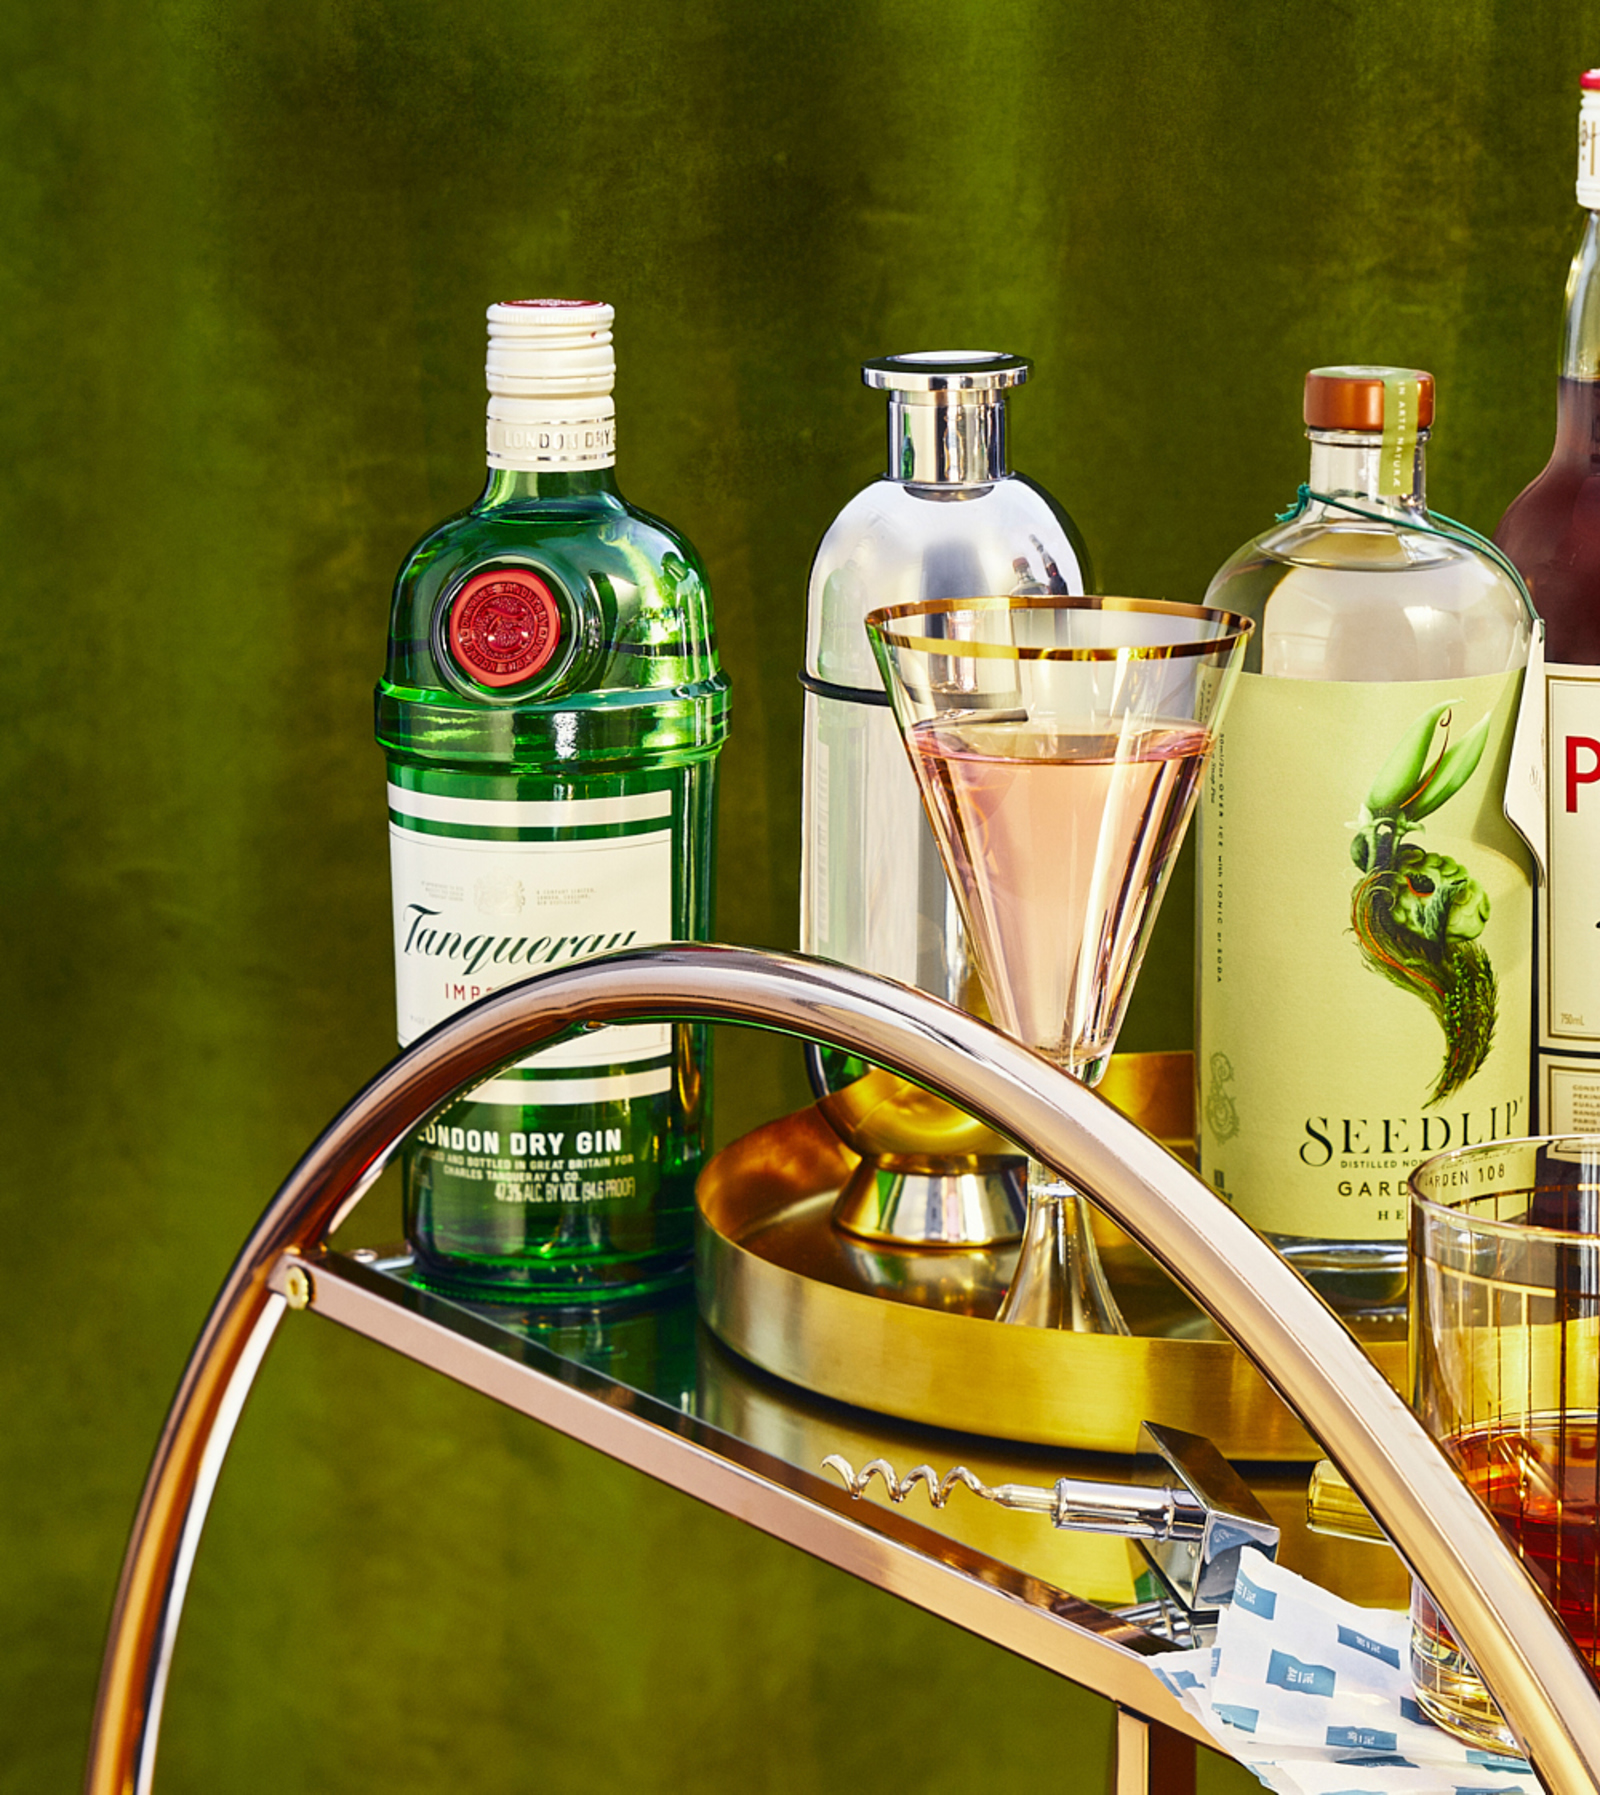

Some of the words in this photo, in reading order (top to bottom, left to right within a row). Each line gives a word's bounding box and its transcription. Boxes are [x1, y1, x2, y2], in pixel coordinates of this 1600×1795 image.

[1397, 382, 1406, 395] IN
[1397, 400, 1406, 431] ARTE
[503, 430, 577, 450] LONDON
[417, 1123, 500, 1155] ONDON
[510, 1132, 564, 1156] DRY
[576, 1128, 622, 1155] GIN
[1299, 1099, 1518, 1167] SEEDLIP
[467, 1156, 512, 1170] BOTTLED
[514, 1159, 527, 1171] IN
[529, 1159, 565, 1171] GREAT
[568, 1157, 612, 1170] BRITAIN
[614, 1153, 634, 1166] FOR
[1340, 1159, 1398, 1169] DISTILLED
[443, 1164, 483, 1180] CHARLES
[486, 1170, 547, 1183] TANQUERAY
[551, 1171, 560, 1182] &
[1478, 1163, 1505, 1182] 108
[545, 1182, 559, 1203] BY
